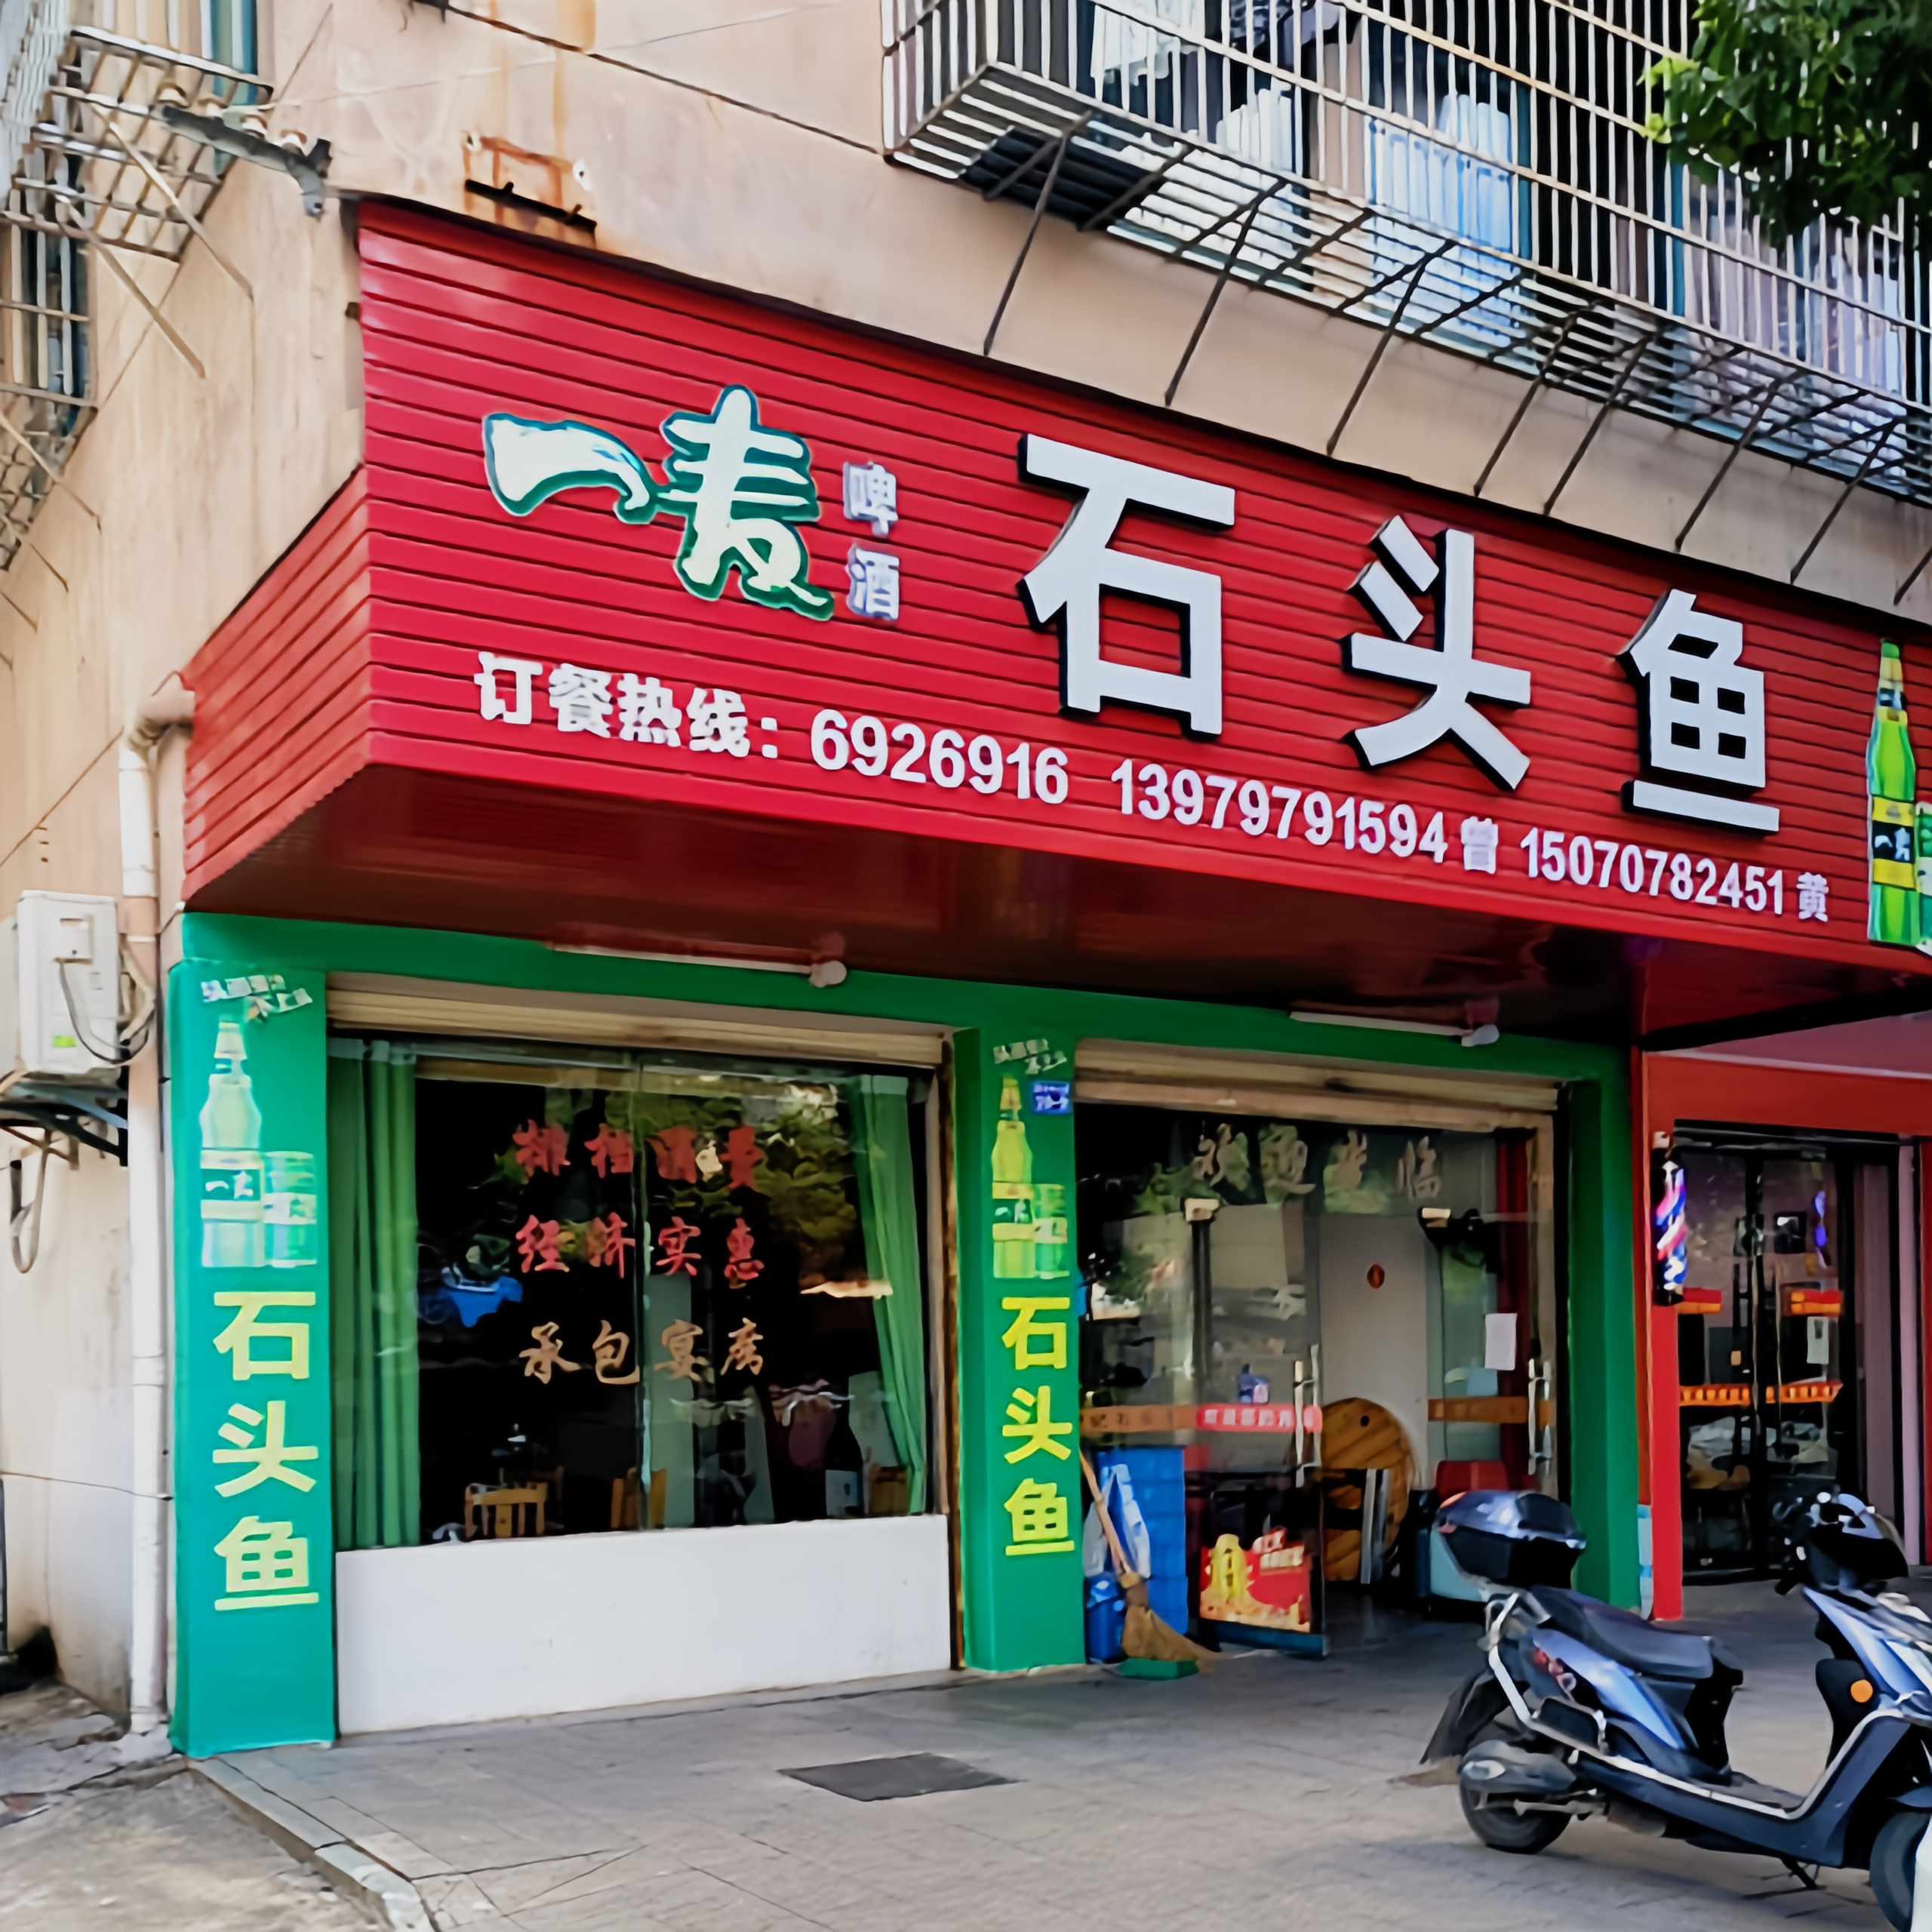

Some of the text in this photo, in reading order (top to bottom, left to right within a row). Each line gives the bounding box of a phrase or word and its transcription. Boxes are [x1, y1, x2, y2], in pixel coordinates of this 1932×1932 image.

[843, 460, 900, 620] 啤酒
[1020, 434, 1780, 832] 石头鱼
[811, 709, 1068, 803] 6926916
[1112, 759, 1447, 863] 13979791594
[1520, 827, 1783, 915] 15070782451
[1797, 872, 1829, 921] 黄
[213, 1291, 318, 1611] 石头鱼
[1001, 1297, 1075, 1555] 石头鱼
